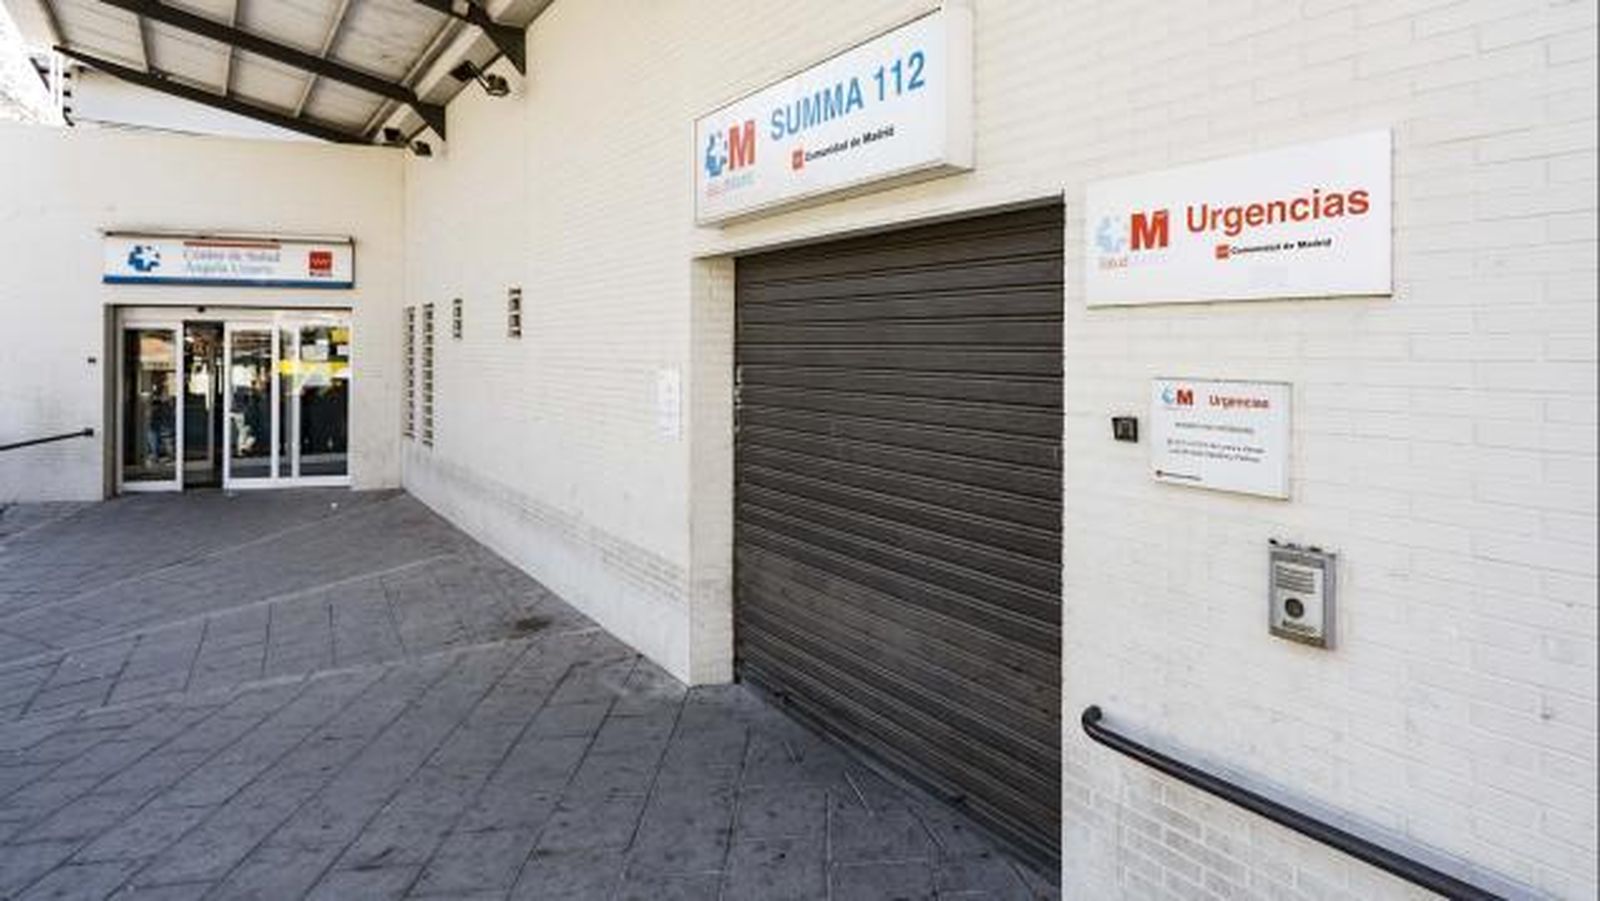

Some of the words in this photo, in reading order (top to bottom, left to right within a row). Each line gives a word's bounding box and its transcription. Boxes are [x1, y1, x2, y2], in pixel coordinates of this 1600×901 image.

[770, 77, 863, 141] SUMMA
[873, 50, 925, 102] 112
[728, 120, 755, 171] M
[850, 136, 861, 147] de
[862, 126, 895, 144] Madrid
[1130, 209, 1169, 251] M
[1186, 188, 1370, 237] Urgencias
[1297, 238, 1331, 248] Madrid
[1208, 394, 1270, 410] Urgencias
